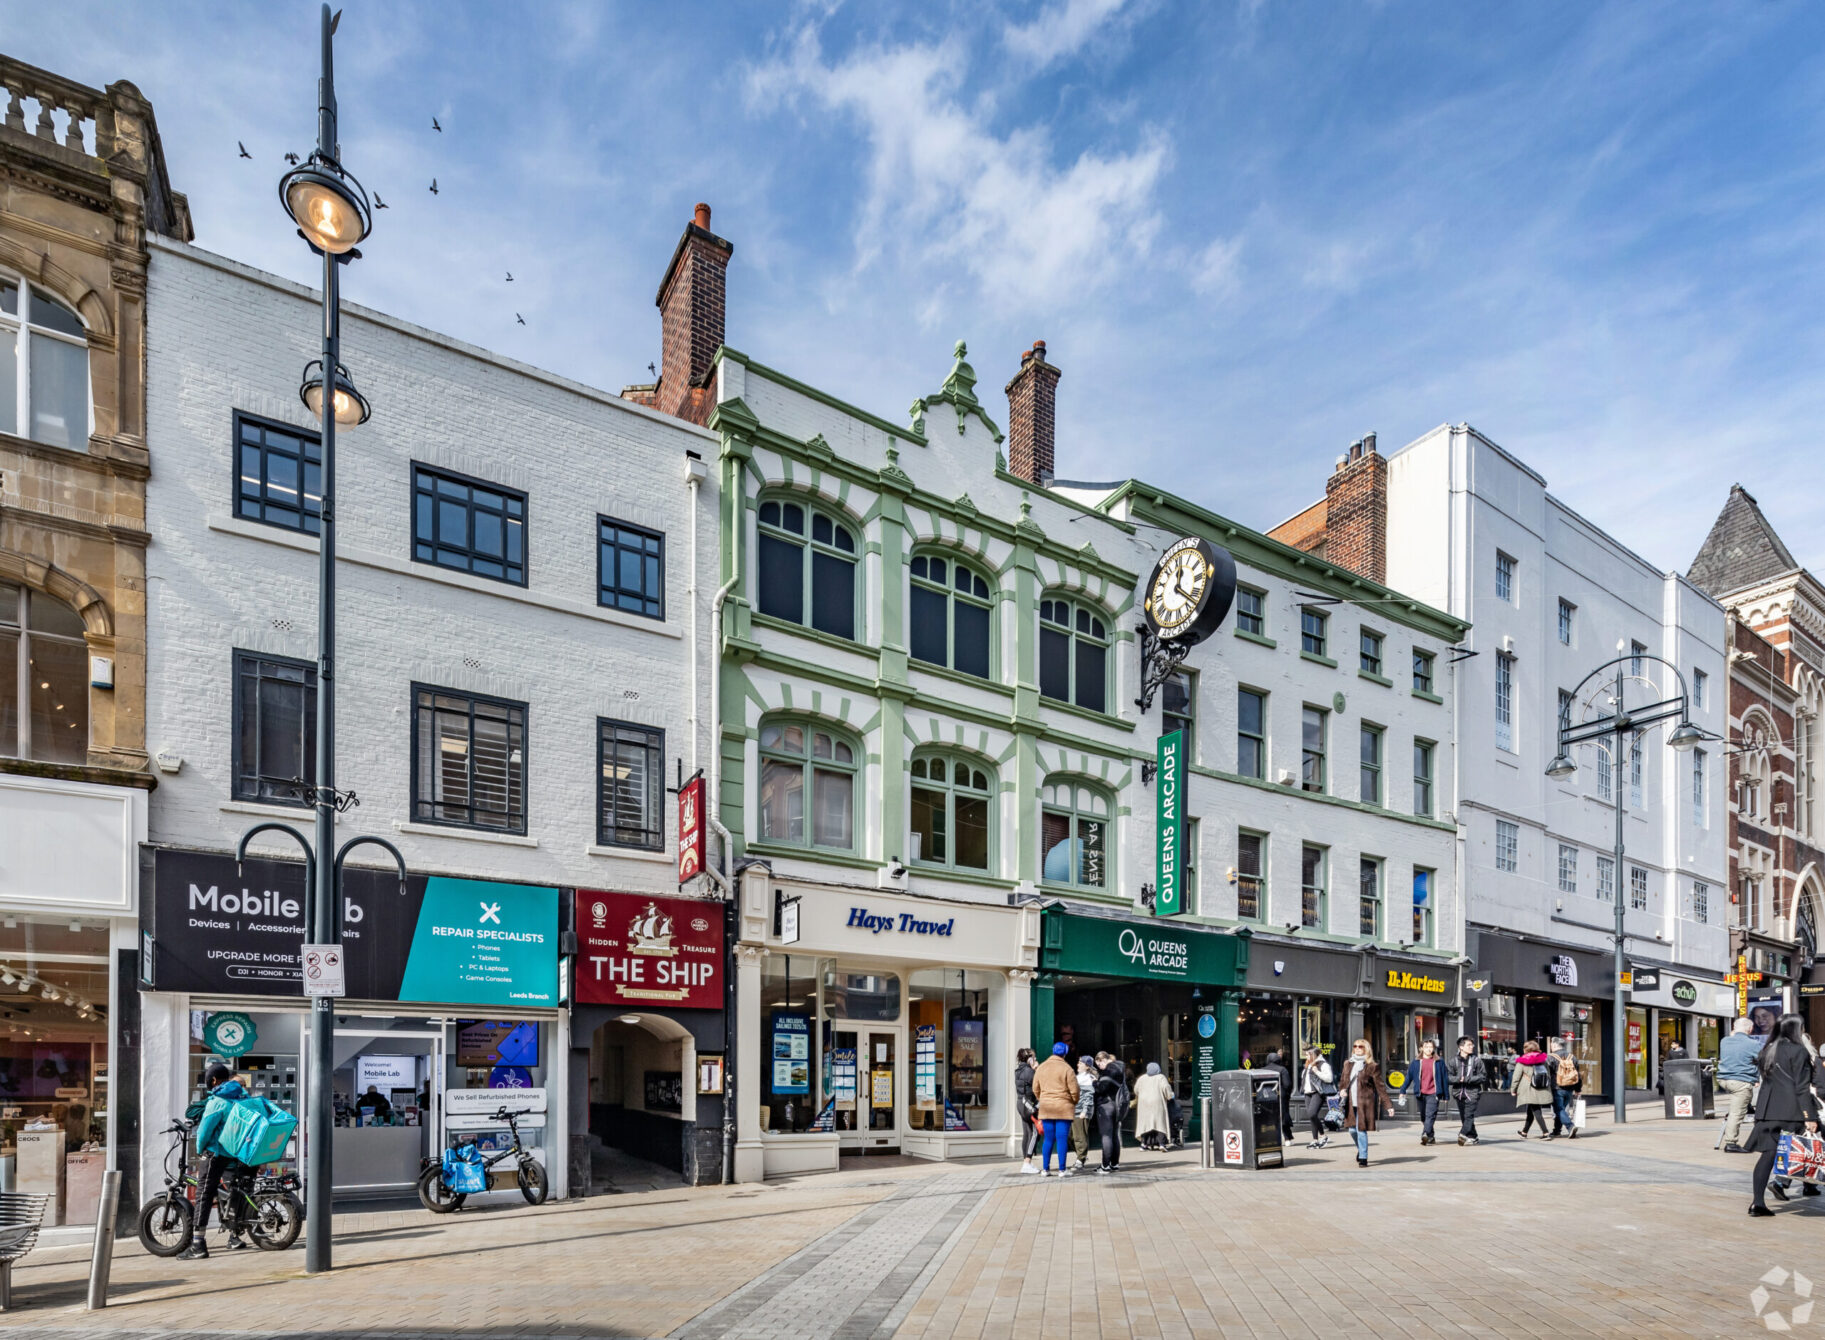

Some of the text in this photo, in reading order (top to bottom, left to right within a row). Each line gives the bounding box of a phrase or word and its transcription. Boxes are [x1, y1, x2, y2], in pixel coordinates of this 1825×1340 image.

[1160, 537, 1199, 565] QUEEN'S
[1162, 618, 1194, 637] ARCADE
[1162, 743, 1176, 904] QUEENS ARCADE
[679, 829, 698, 853] THE SHIP
[189, 883, 300, 918] Mobile
[189, 918, 231, 930] Devices
[341, 929, 361, 938] airs
[846, 907, 955, 937] Hays Travel
[432, 926, 544, 944] REPAIR SPECIALISTS
[588, 937, 619, 947] HIDDEN
[477, 944, 501, 952] Phones
[682, 944, 716, 954] TREASURE
[1149, 940, 1187, 956] QUEENS
[207, 950, 261, 962] UPGRADE
[263, 954, 294, 964] MORE
[478, 954, 501, 962] Tablets
[1149, 955, 1188, 969] ARCADE
[1559, 955, 1570, 965] THE
[484, 965, 510, 973] Laptops
[589, 956, 645, 982] THE
[656, 960, 714, 986] SHIP
[1551, 963, 1570, 975] NORTH
[485, 975, 513, 983] Consoles
[1556, 974, 1570, 985] FACE
[1724, 973, 1760, 985] JESUS
[1674, 985, 1696, 1000] schuh
[916, 1025, 936, 1040] Smile
[1629, 1025, 1640, 1036] SALE
[213, 1042, 232, 1054] MOBILE
[831, 1048, 856, 1061] Smile
